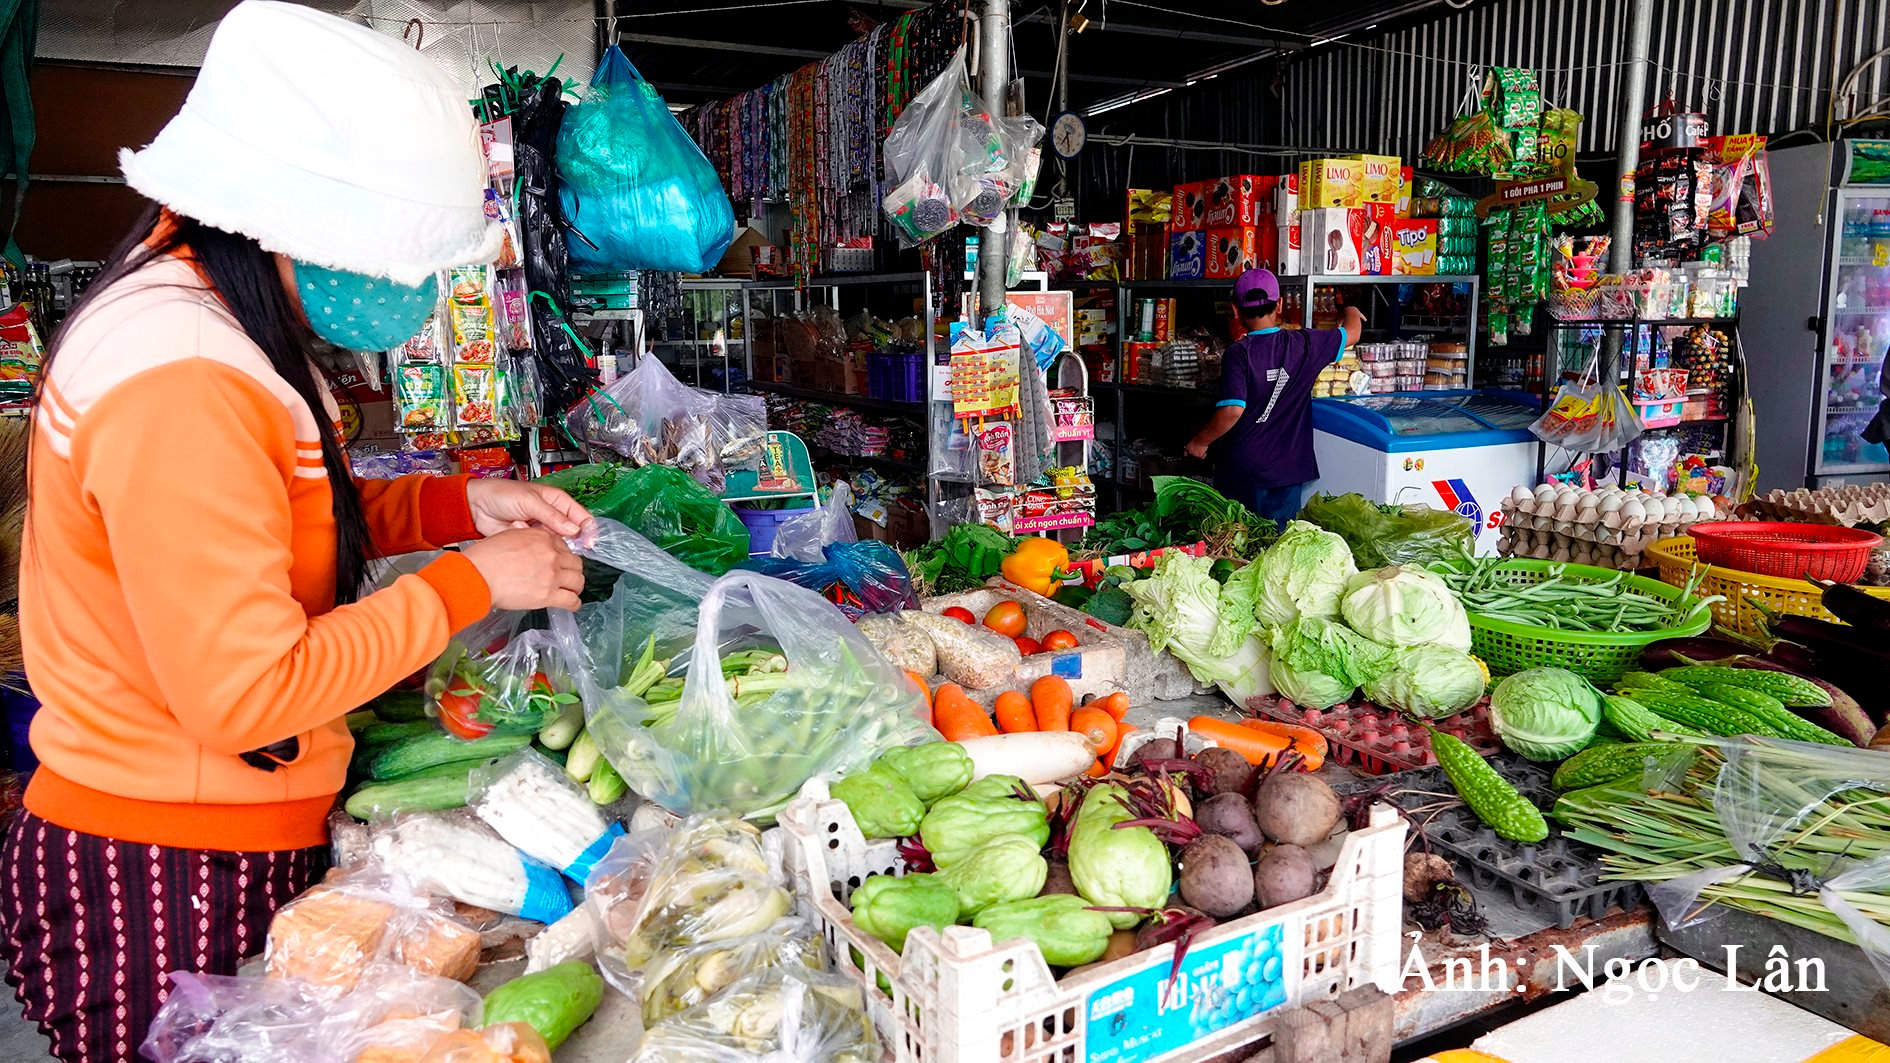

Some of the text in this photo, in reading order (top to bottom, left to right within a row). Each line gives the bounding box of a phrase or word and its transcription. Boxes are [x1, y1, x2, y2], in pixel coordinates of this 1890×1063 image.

[1541, 136, 1568, 161] HỐ
[1729, 137, 1748, 145] MUA
[1327, 167, 1351, 180] LIMO
[1365, 163, 1388, 176] LIMO
[1504, 180, 1564, 198] 1 GÓI PHA 1 PHIN
[1176, 189, 1185, 227] Camely
[1397, 228, 1427, 247] Tipo
[1209, 234, 1219, 273] Camely
[1256, 367, 1290, 423] 7
[1058, 428, 1082, 438] chuẩn
[1024, 518, 1037, 529] xốt
[1038, 518, 1058, 531] ngon
[1059, 515, 1082, 525] chuẩn
[1083, 516, 1090, 525] vị
